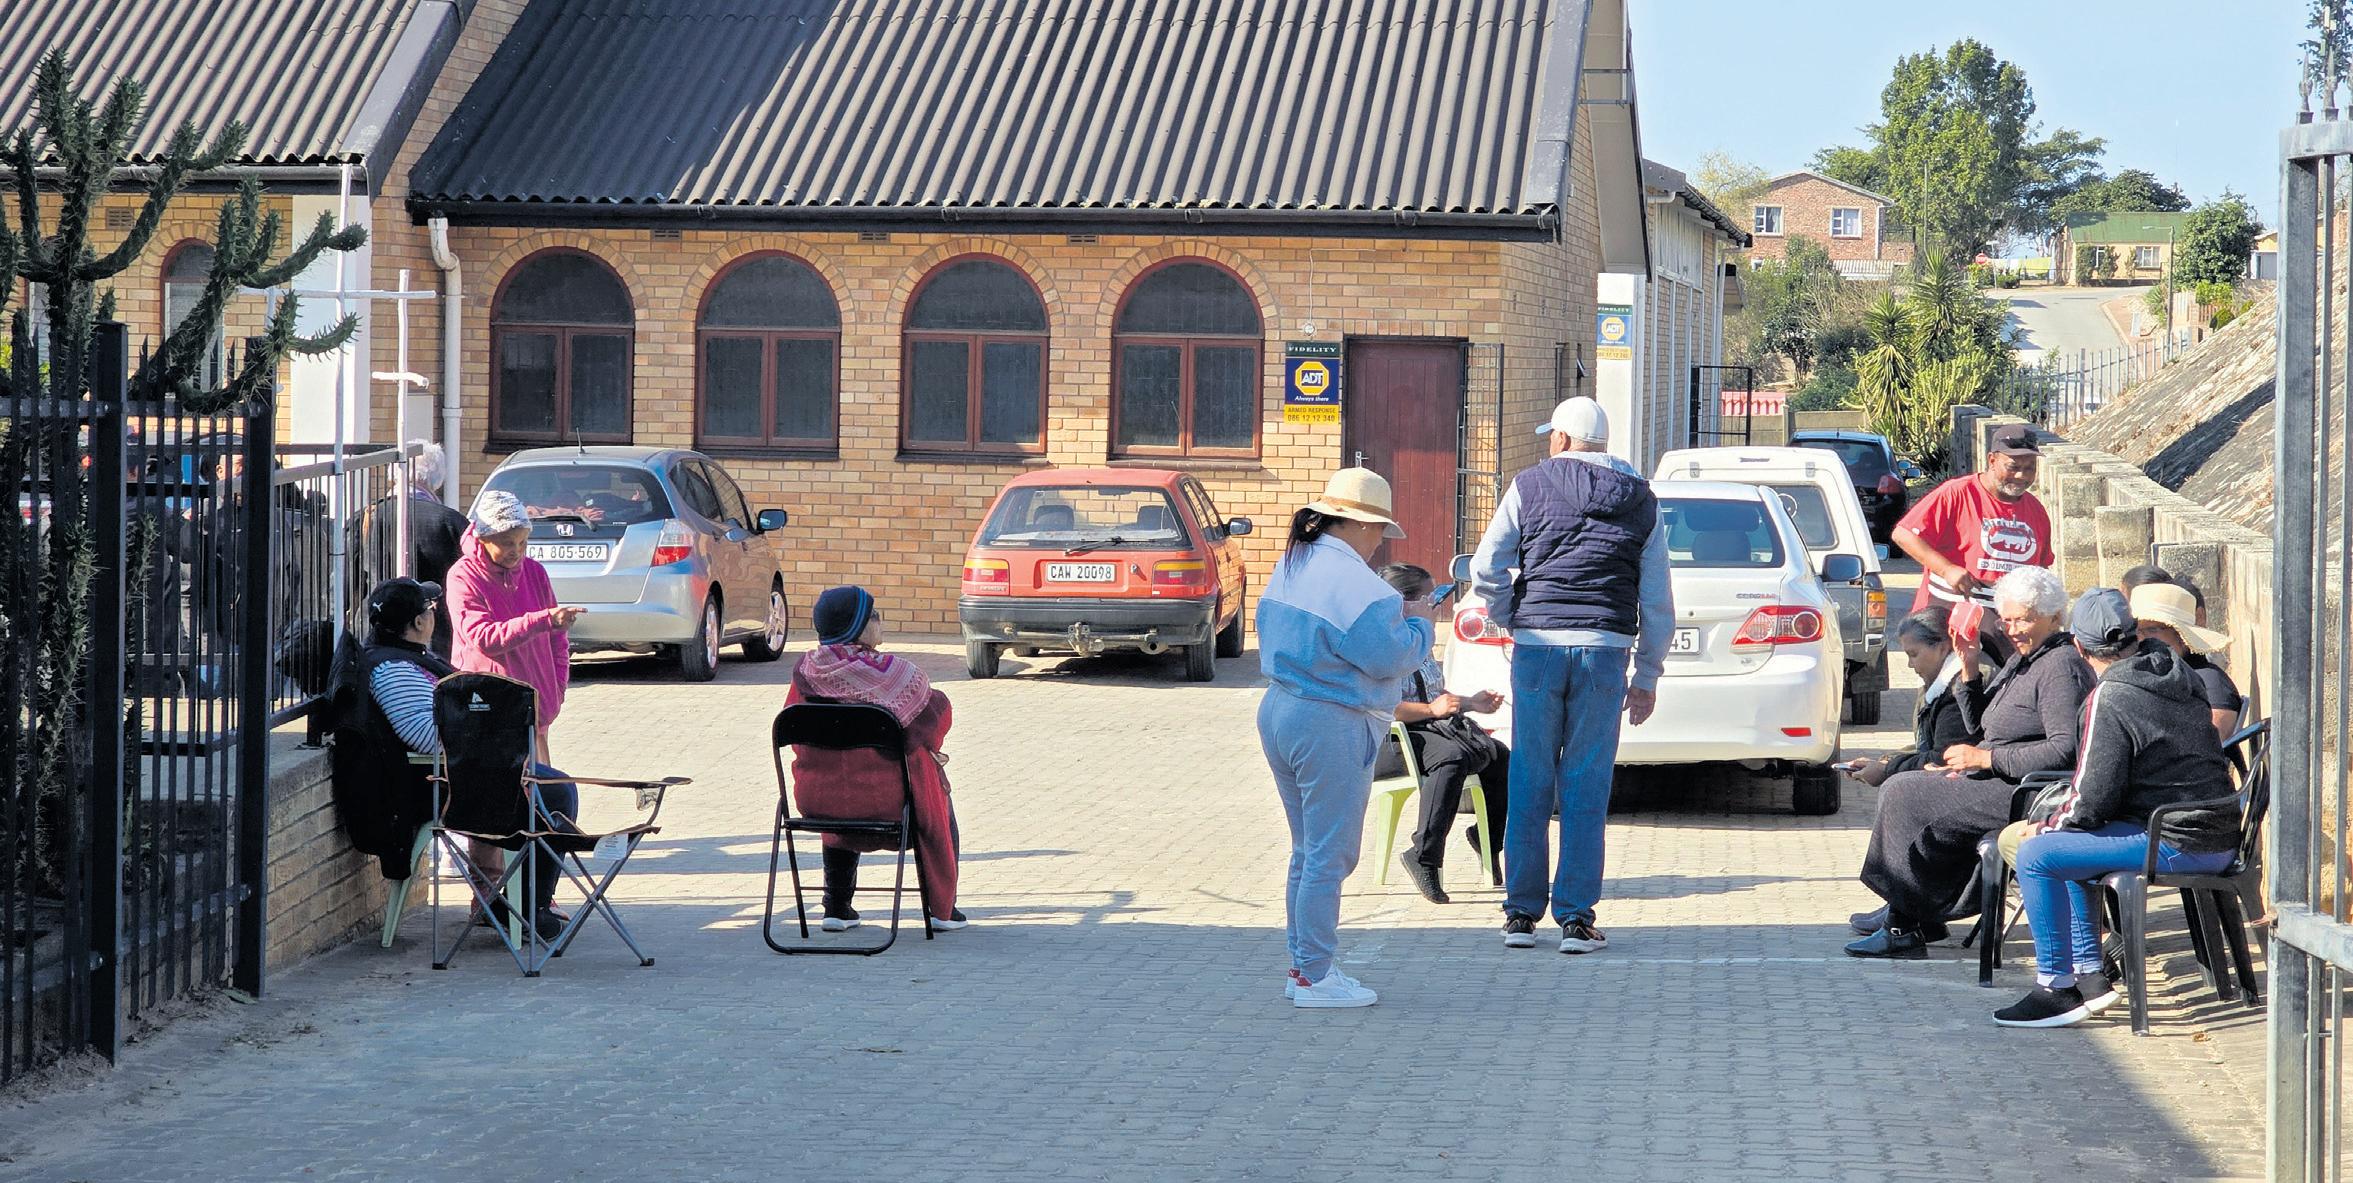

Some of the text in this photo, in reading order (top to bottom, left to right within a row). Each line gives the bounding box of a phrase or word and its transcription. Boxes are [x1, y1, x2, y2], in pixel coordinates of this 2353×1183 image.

[1301, 372, 1324, 384] ADT
[1295, 395, 1314, 403] Always
[528, 546, 544, 560] CA
[1050, 564, 1112, 579] CAW 20098
